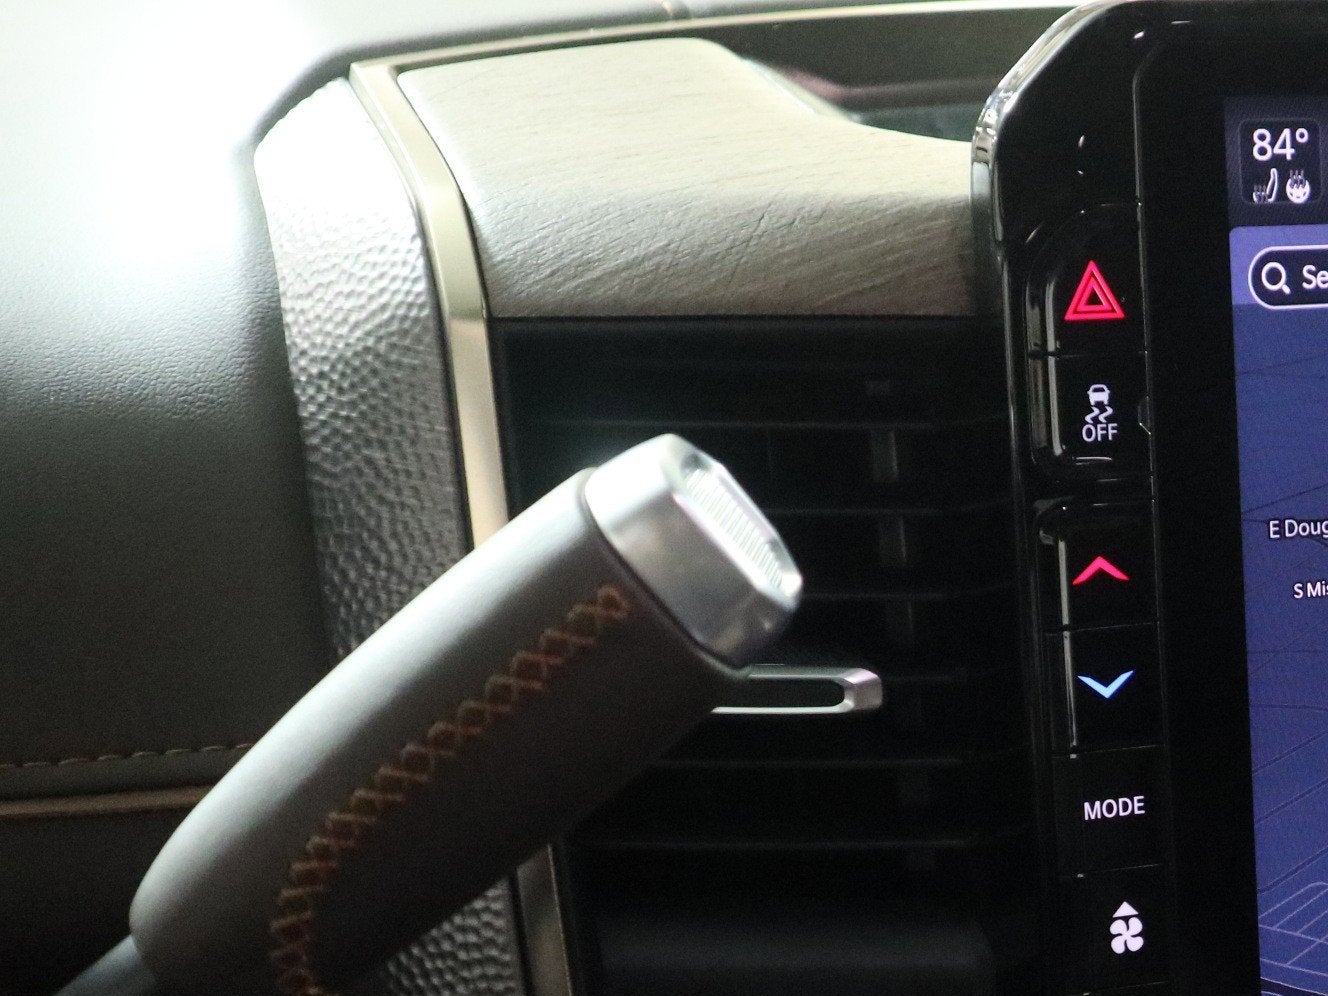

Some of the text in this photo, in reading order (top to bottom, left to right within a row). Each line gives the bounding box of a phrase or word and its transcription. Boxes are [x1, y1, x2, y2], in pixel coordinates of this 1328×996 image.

[1082, 423, 1118, 442] OFF
[1269, 520, 1280, 538] E
[1294, 583, 1303, 598] S
[1084, 795, 1145, 820] MODE
